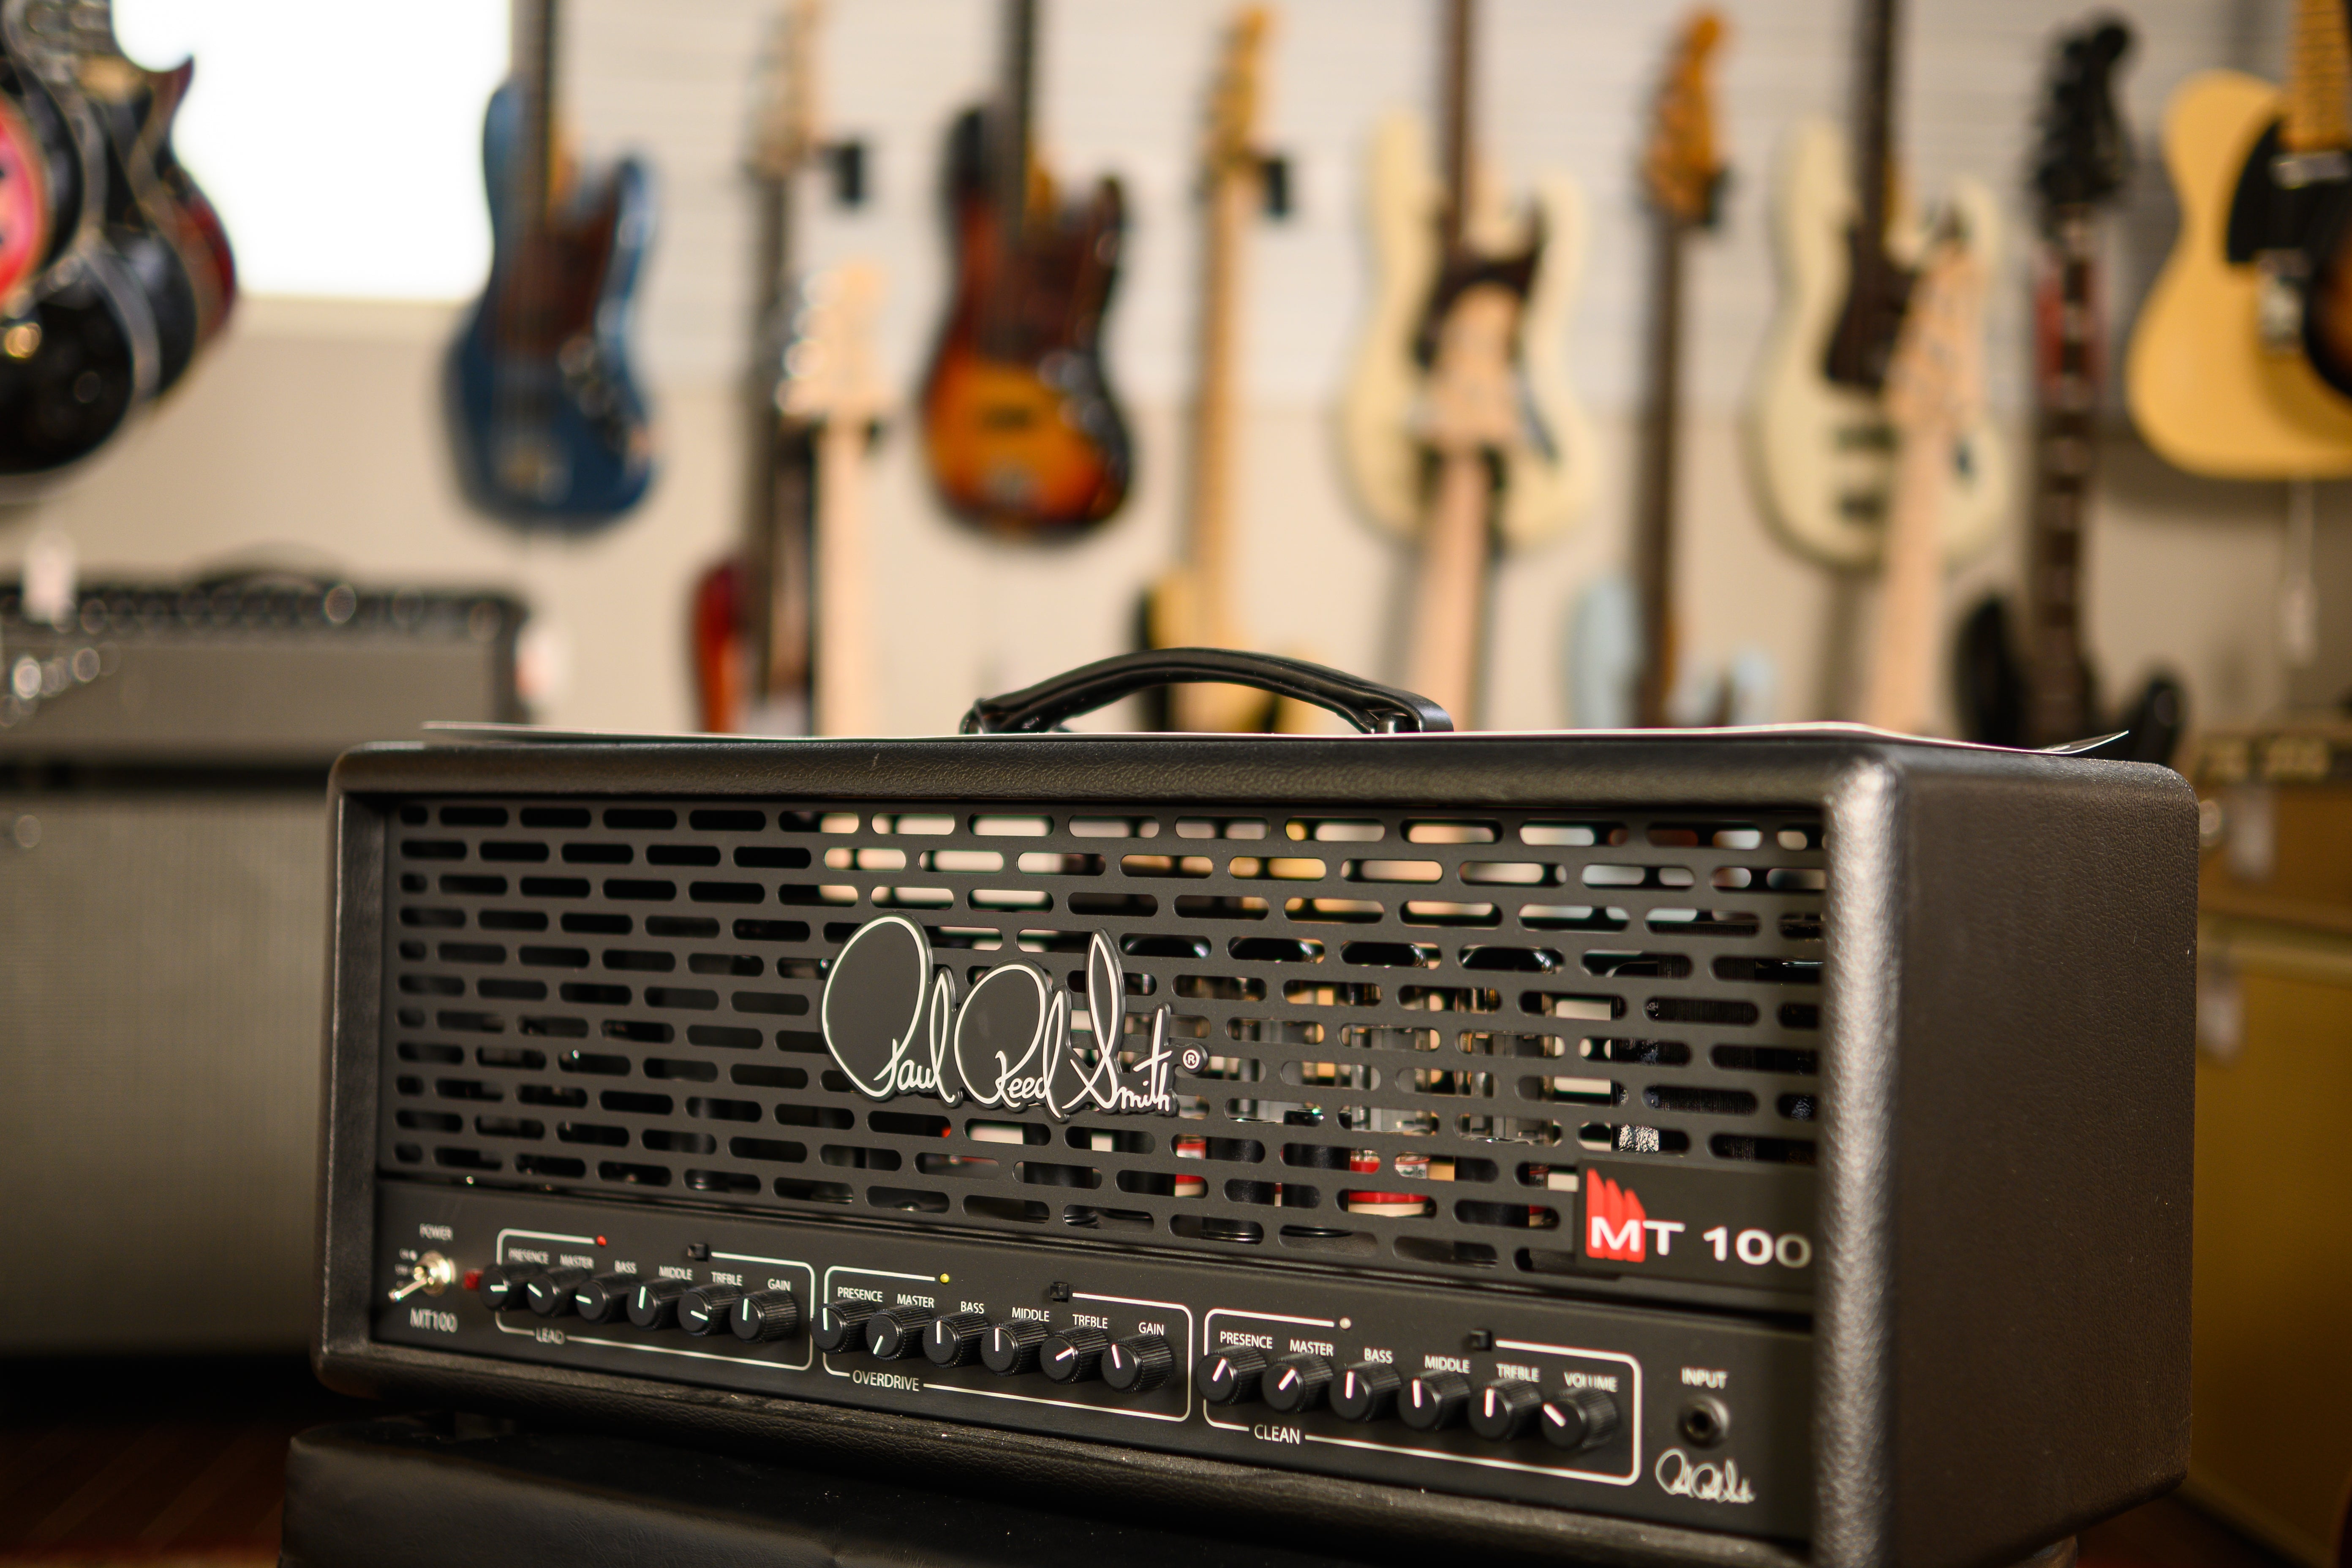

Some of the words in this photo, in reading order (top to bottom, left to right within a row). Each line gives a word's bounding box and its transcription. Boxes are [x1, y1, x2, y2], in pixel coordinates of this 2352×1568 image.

[822, 917, 955, 1103] Paul
[954, 964, 1063, 1118] Reed
[419, 1223, 453, 1241] POWER
[1591, 1216, 1685, 1255] MT
[1703, 1226, 1812, 1269] 100
[508, 1248, 549, 1265] PRESENCE
[560, 1254, 594, 1269] MASTER
[615, 1260, 637, 1274] BASS
[659, 1265, 693, 1281] MIDDLE
[711, 1271, 743, 1286] TREBLE
[768, 1278, 791, 1291] GAIN
[838, 1287, 883, 1302] PRESENCE
[897, 1294, 934, 1308] MASTER
[960, 1301, 984, 1314] BASS
[1012, 1307, 1050, 1322] MIDDLE
[410, 1308, 458, 1333] MT100
[1073, 1314, 1108, 1329] TREBLE
[1138, 1322, 1164, 1336] GAIN
[536, 1328, 565, 1345] LEAD
[1220, 1331, 1272, 1349] PRESENCE
[1290, 1339, 1334, 1356] MASTER
[1364, 1348, 1392, 1364] BASS
[1424, 1355, 1470, 1373] MIDDLE
[852, 1370, 919, 1391] OVERDRIVE
[1496, 1363, 1540, 1383] TREBLE
[1564, 1371, 1618, 1392] VOLUME
[1681, 1367, 1728, 1389] INPUT
[1255, 1424, 1300, 1445] CLEAN
